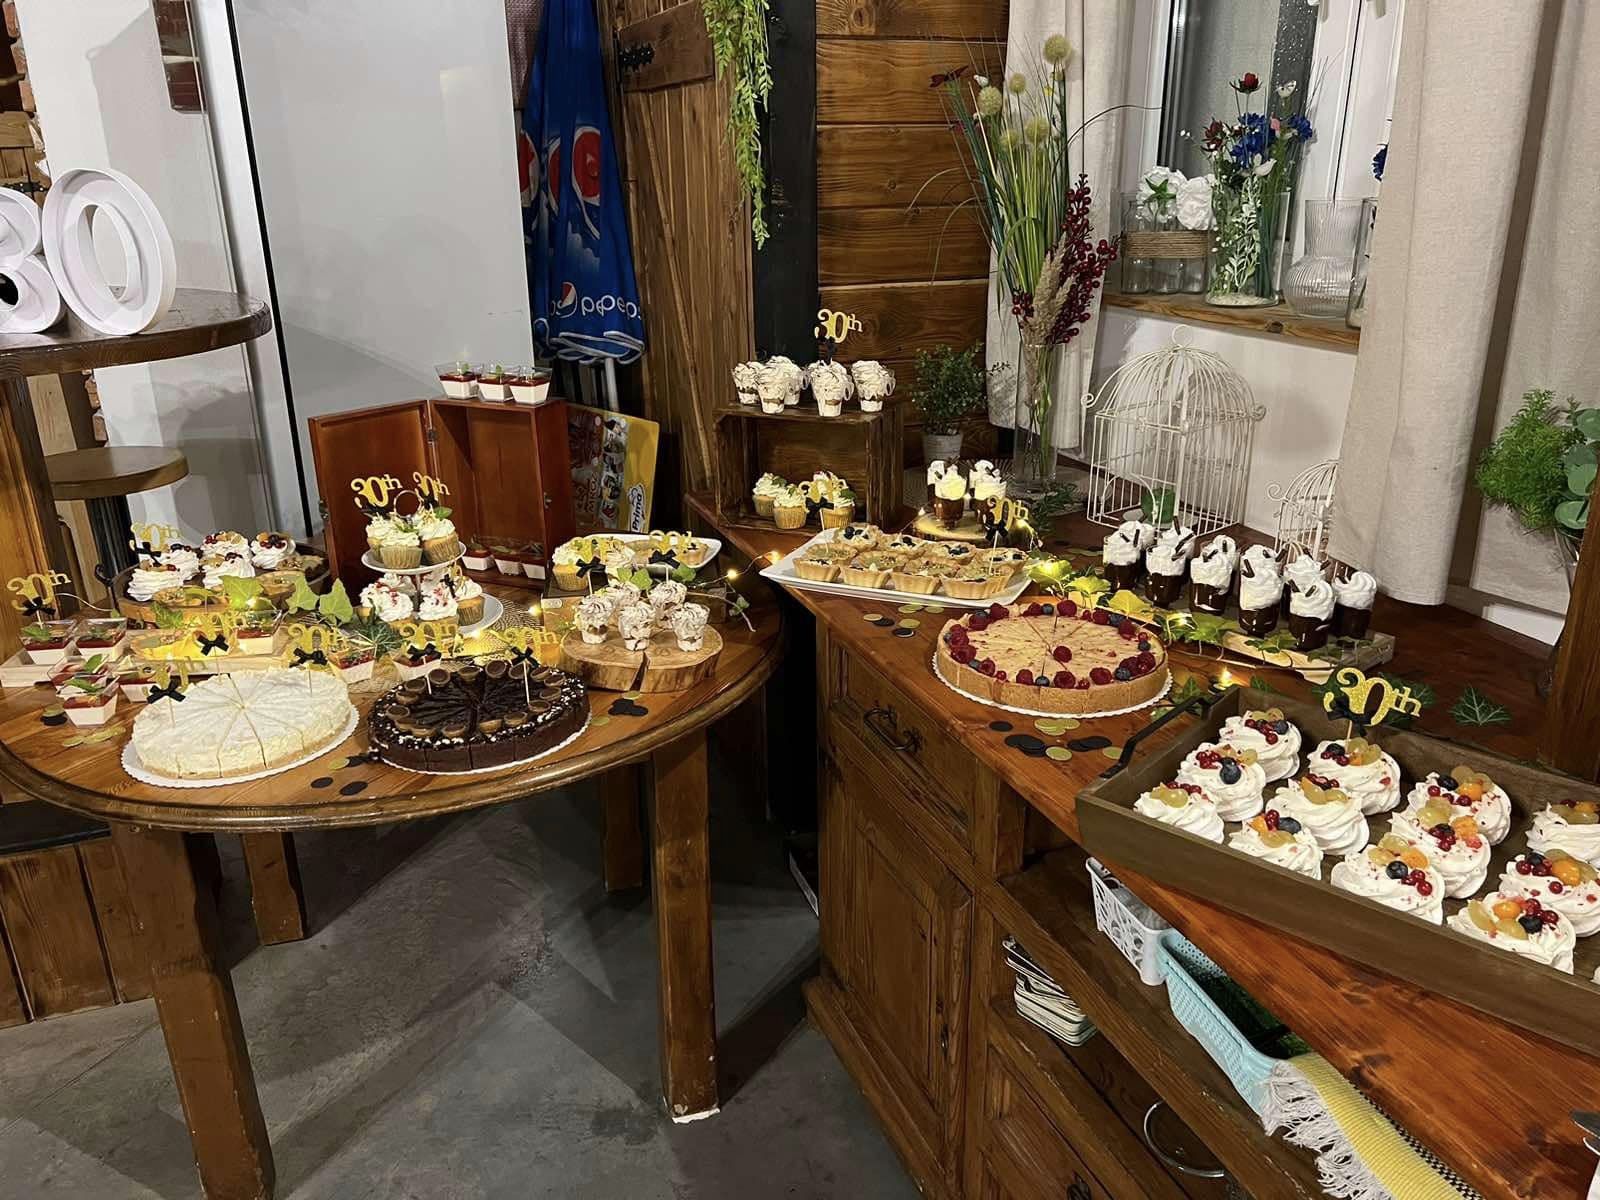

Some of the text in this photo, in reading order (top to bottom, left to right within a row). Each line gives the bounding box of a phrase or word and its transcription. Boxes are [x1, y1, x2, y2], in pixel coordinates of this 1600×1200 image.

[814, 308, 863, 343] 30th
[350, 474, 403, 508] 30th
[632, 493, 642, 531] Prima
[982, 495, 1029, 531] 30th
[6, 569, 72, 611] 30th
[1323, 667, 1422, 726] 30th
